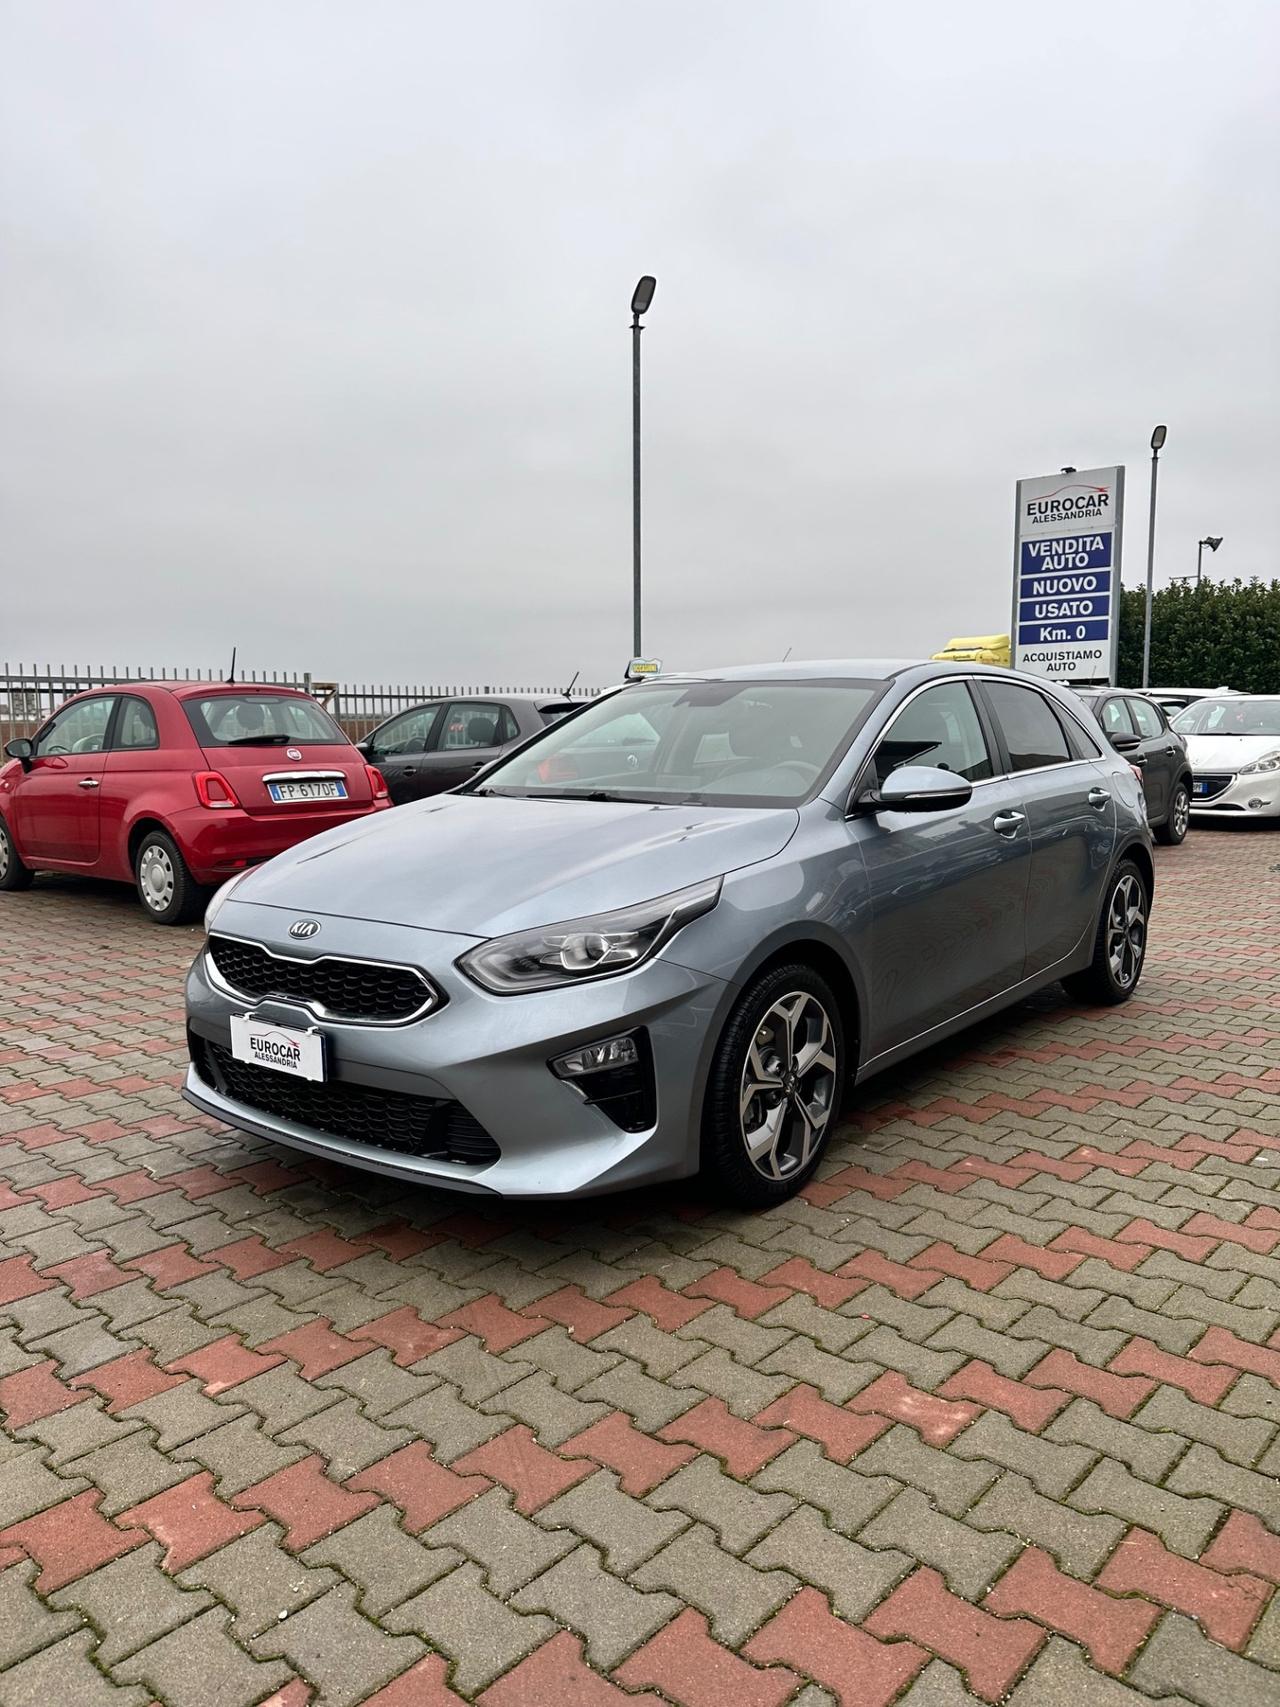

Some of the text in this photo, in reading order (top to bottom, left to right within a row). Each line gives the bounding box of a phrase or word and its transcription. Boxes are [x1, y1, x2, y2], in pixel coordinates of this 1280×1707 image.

[1027, 493, 1109, 516] EUROCAR
[1032, 508, 1102, 524] ALESSANDRIA
[1028, 536, 1104, 557] VENDITA
[1041, 552, 1089, 571] AUTO
[1033, 576, 1097, 595] NUOVO
[1034, 600, 1093, 618] USATO
[1040, 625, 1086, 641] Km. 0
[1022, 649, 1102, 662] ACQUISTIAMO
[1046, 662, 1076, 672] AUTO
[278, 784, 295, 798] FP
[299, 783, 336, 797] 617DF
[290, 921, 314, 935] KIA
[250, 1036, 301, 1062] EUROCAR
[254, 1051, 298, 1069] ALESSANDRIA
